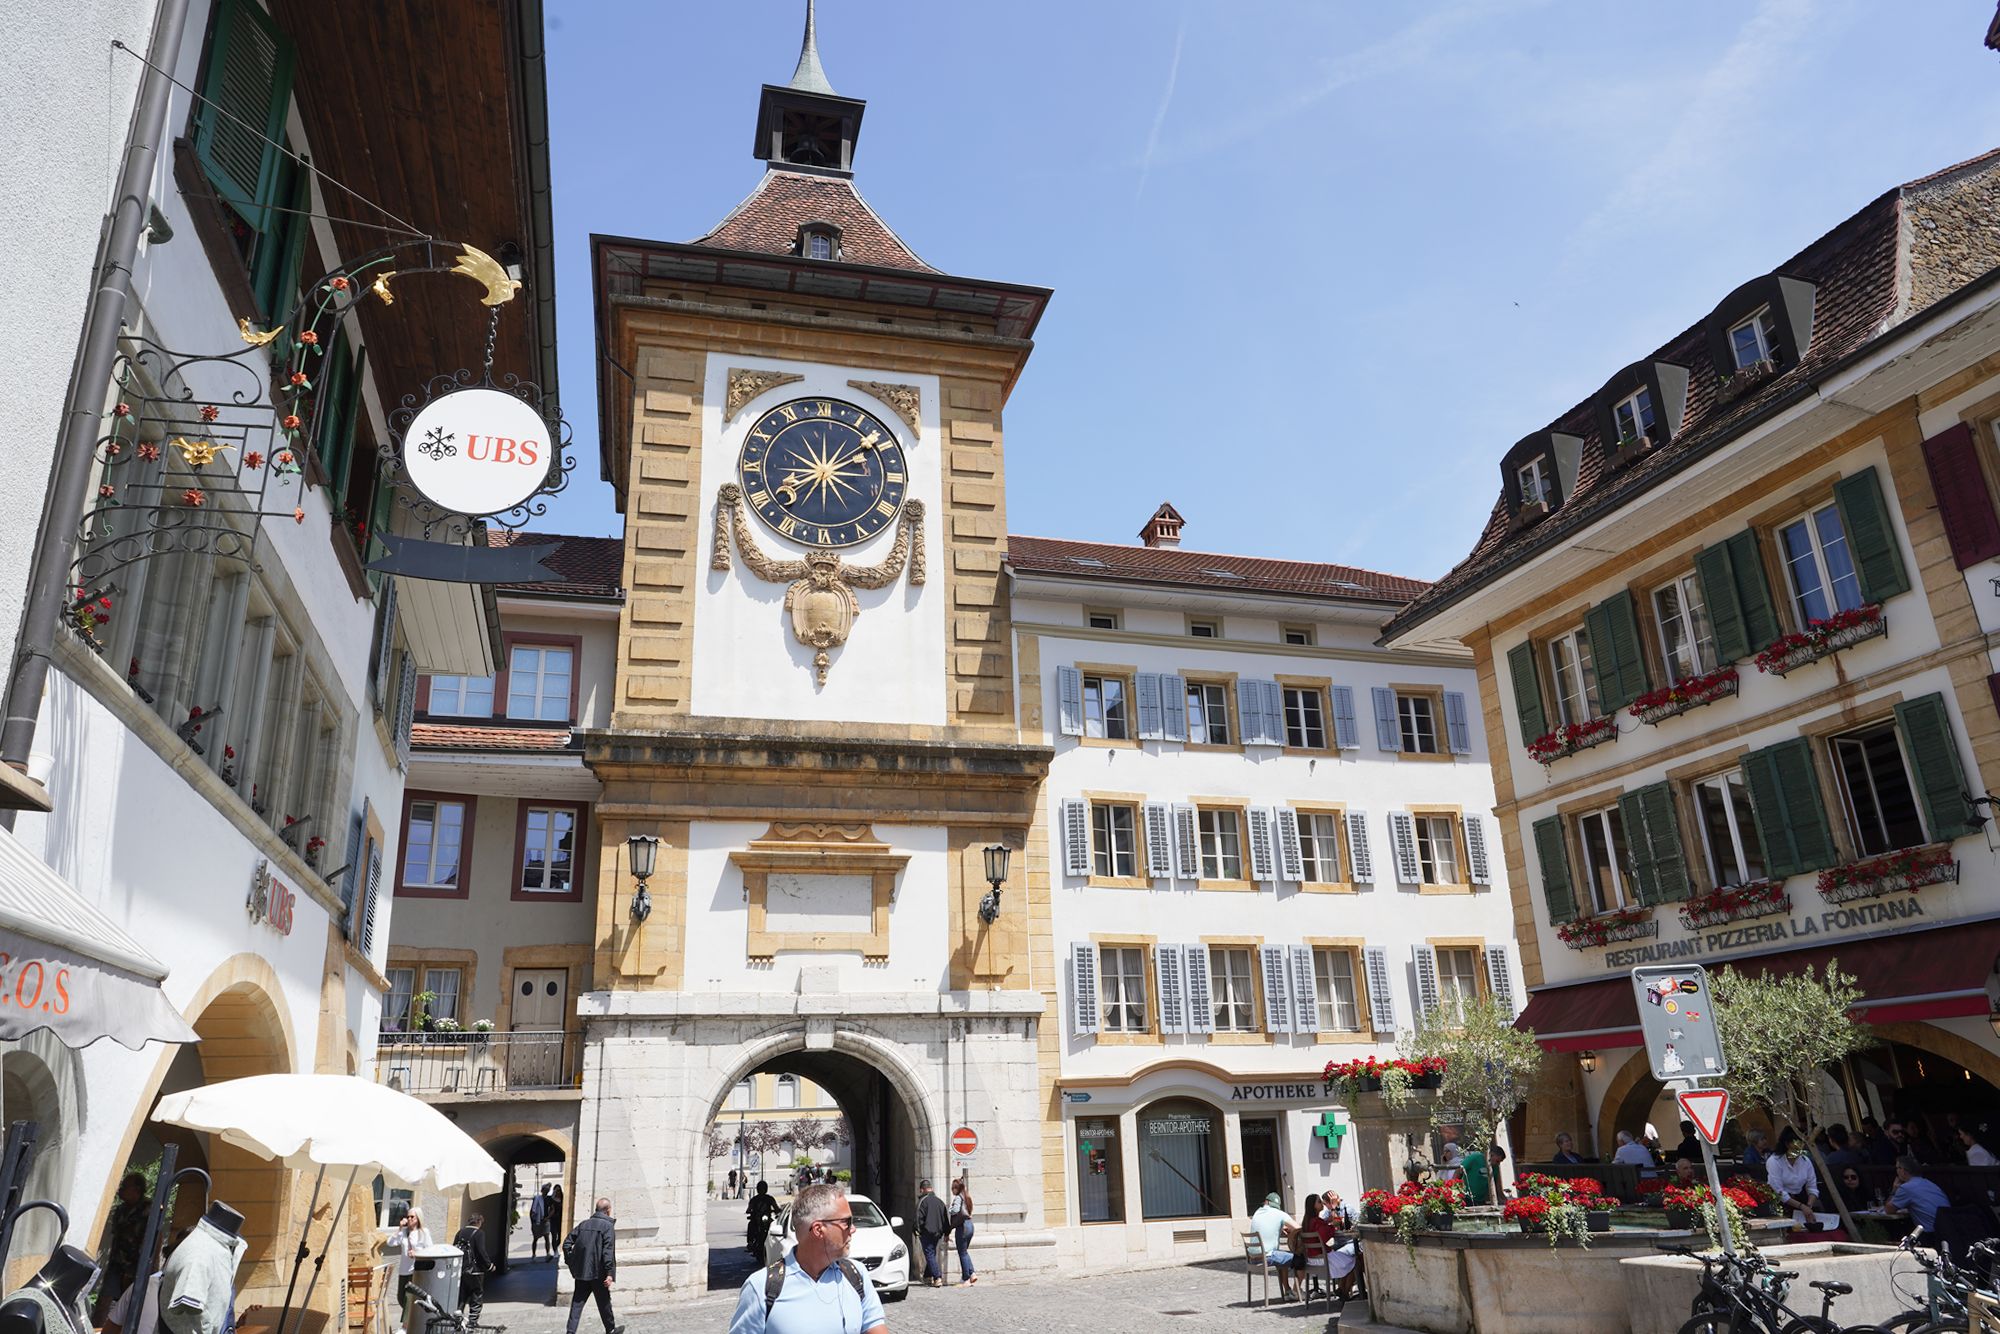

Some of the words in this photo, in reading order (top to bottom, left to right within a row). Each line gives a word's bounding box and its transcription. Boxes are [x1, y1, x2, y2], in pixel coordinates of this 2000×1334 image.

[780, 406, 797, 423] XI
[817, 402, 831, 417] XII
[854, 414, 865, 428] I
[752, 427, 772, 443] X
[467, 434, 538, 466] UBS
[877, 440, 894, 452] II
[744, 459, 760, 471] IX
[887, 472, 903, 483] III
[750, 490, 770, 510] VIII
[877, 500, 896, 517] IIII
[817, 528, 832, 544] VI
[855, 523, 869, 539] V
[268, 877, 296, 936] UBS
[1605, 936, 1703, 968] RESTAURANT
[1706, 922, 1788, 951] PIZZERIA
[1790, 916, 1818, 937] LA
[1821, 897, 1924, 932] FONTANA
[1231, 1084, 1316, 1100] APOTHEKE
[1149, 1121, 1210, 1133] BERNTOR-APOTHEKE
